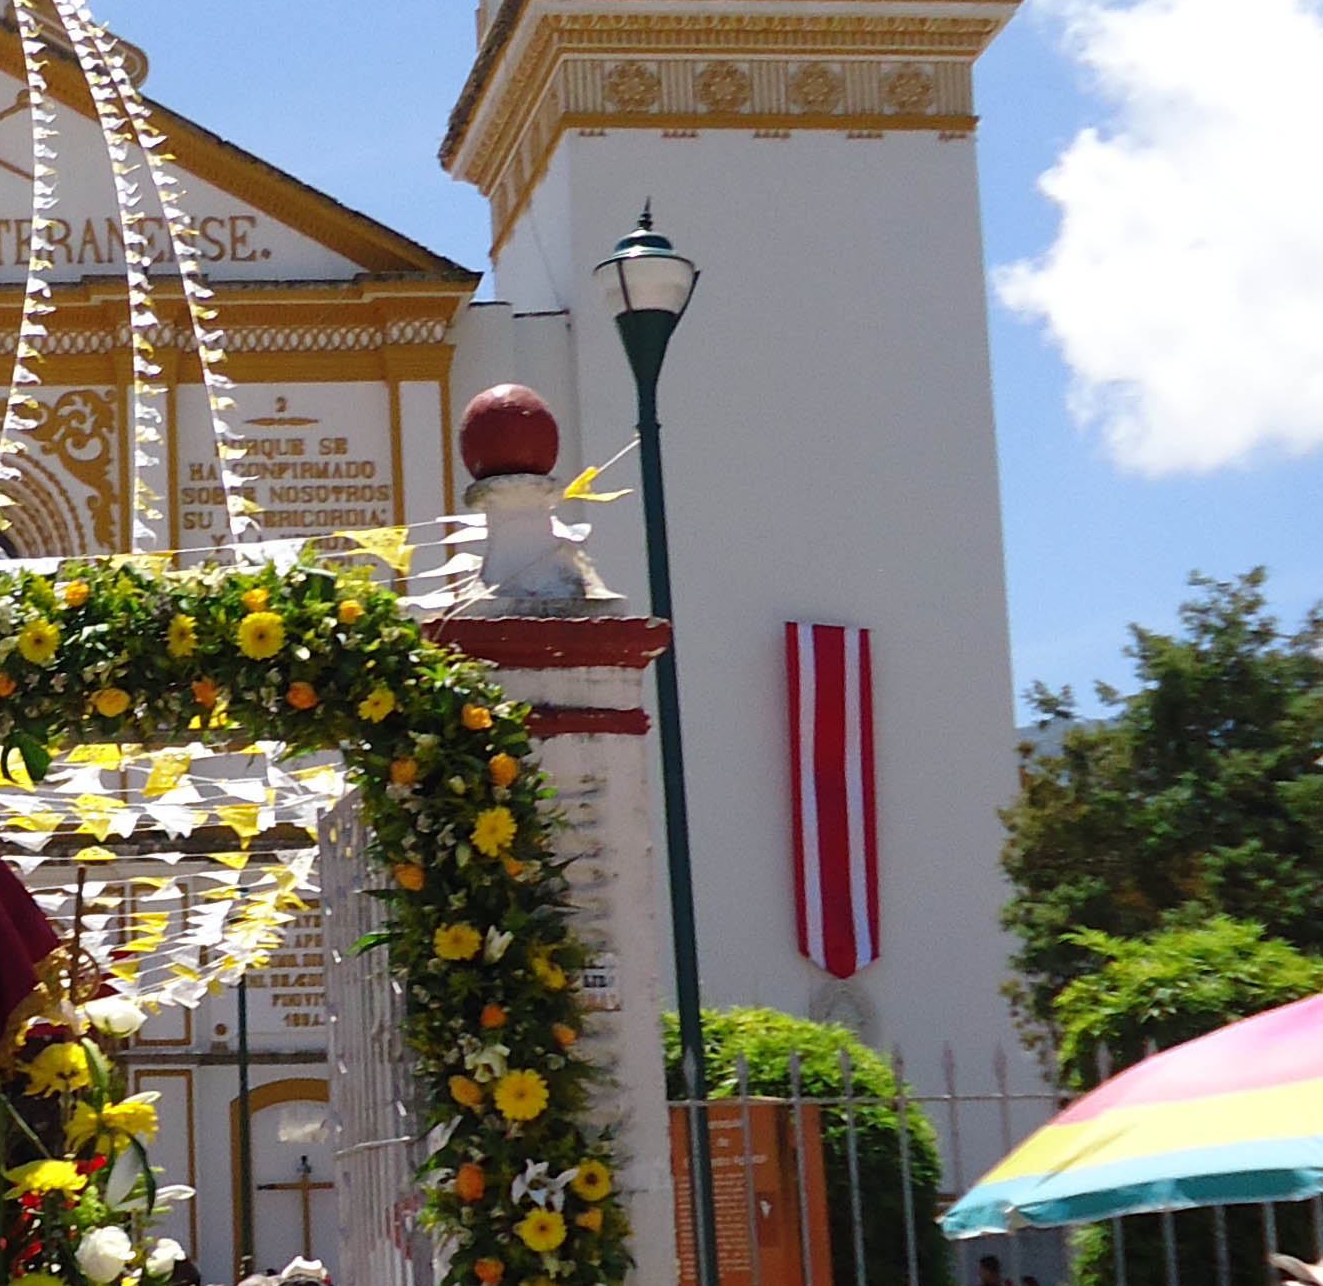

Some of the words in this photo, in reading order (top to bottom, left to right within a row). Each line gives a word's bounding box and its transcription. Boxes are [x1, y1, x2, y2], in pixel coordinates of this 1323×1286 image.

[276, 396, 287, 413] 2
[214, 438, 304, 460] RQUE
[318, 437, 348, 456] SE
[189, 463, 218, 481] HA
[270, 484, 390, 504] NOSOTROS
[183, 511, 214, 530] SU
[223, 510, 387, 529] ERICORDIA;
